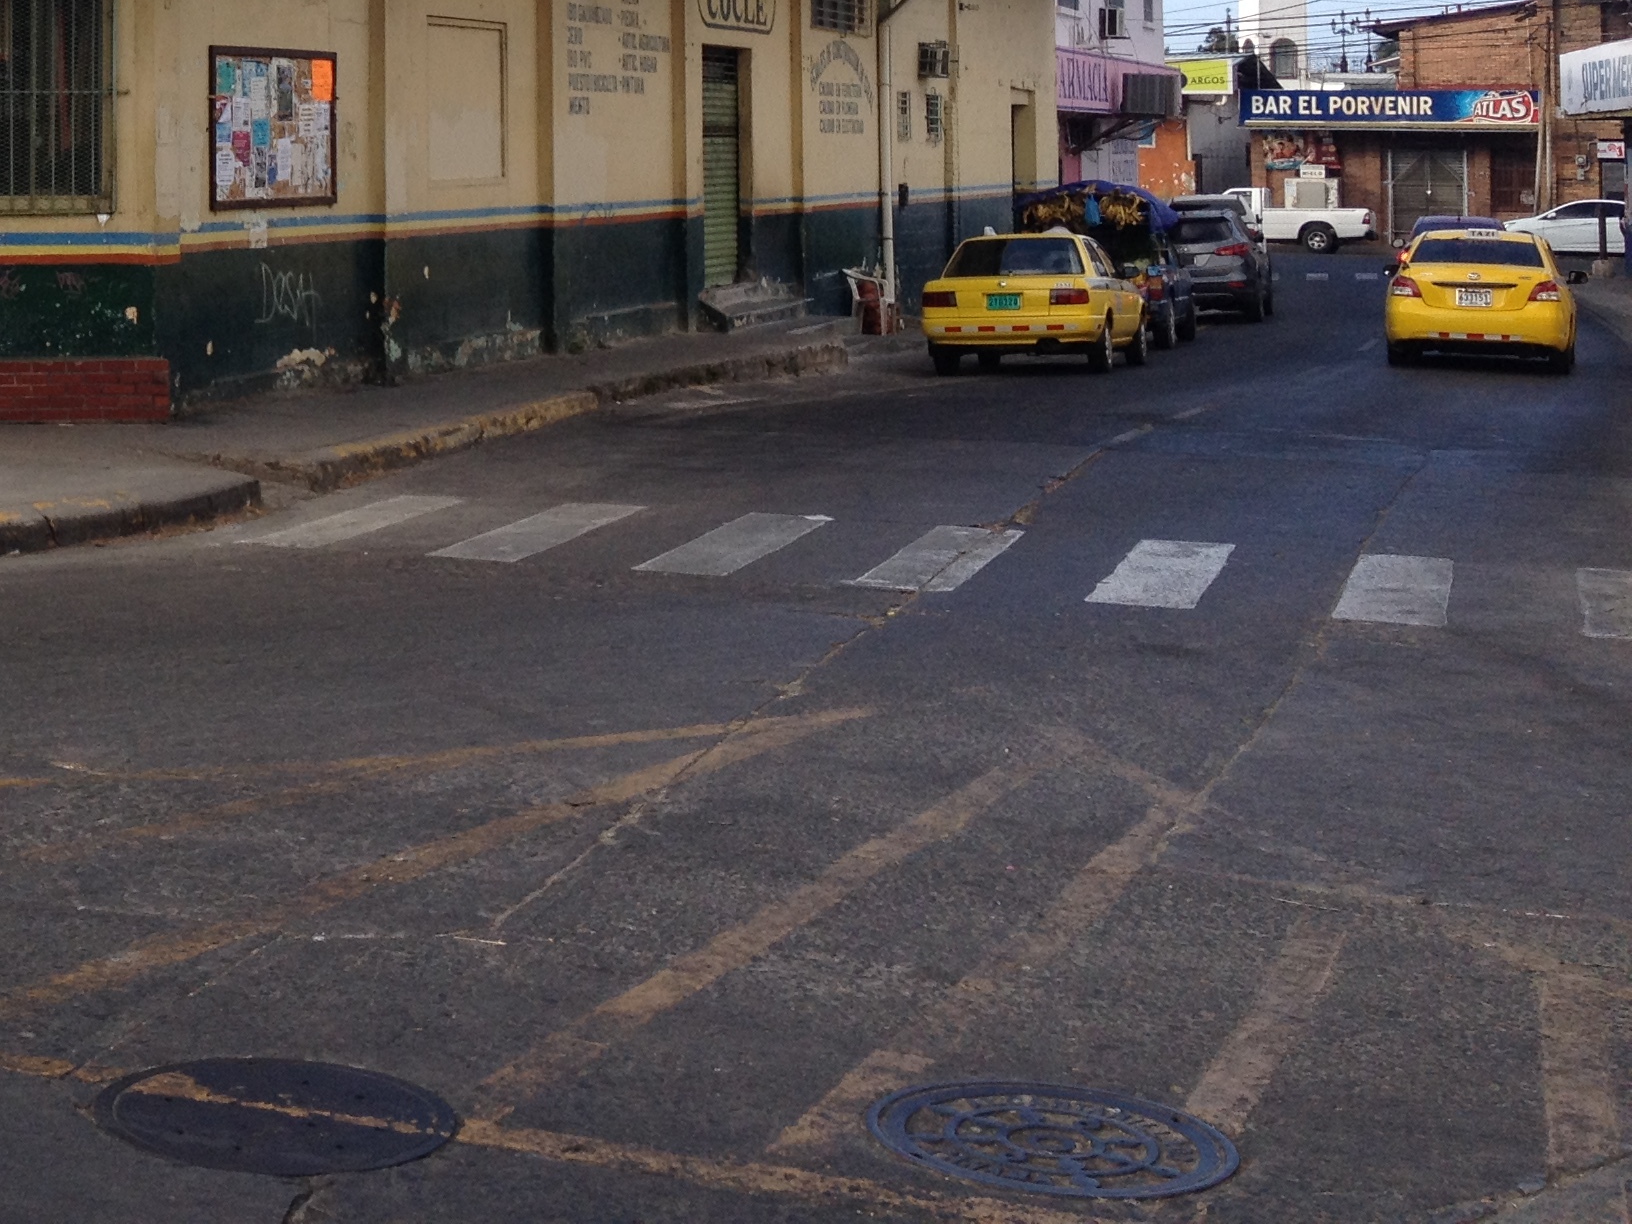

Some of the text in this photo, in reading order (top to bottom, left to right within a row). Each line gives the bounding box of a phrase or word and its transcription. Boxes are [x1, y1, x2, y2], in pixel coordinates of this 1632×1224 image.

[1057, 57, 1109, 103] ARMACIA
[1190, 76, 1226, 85] ARGOS
[1251, 95, 1433, 116] BAR EL PORVENIR
[1474, 97, 1527, 118] ATLAS
